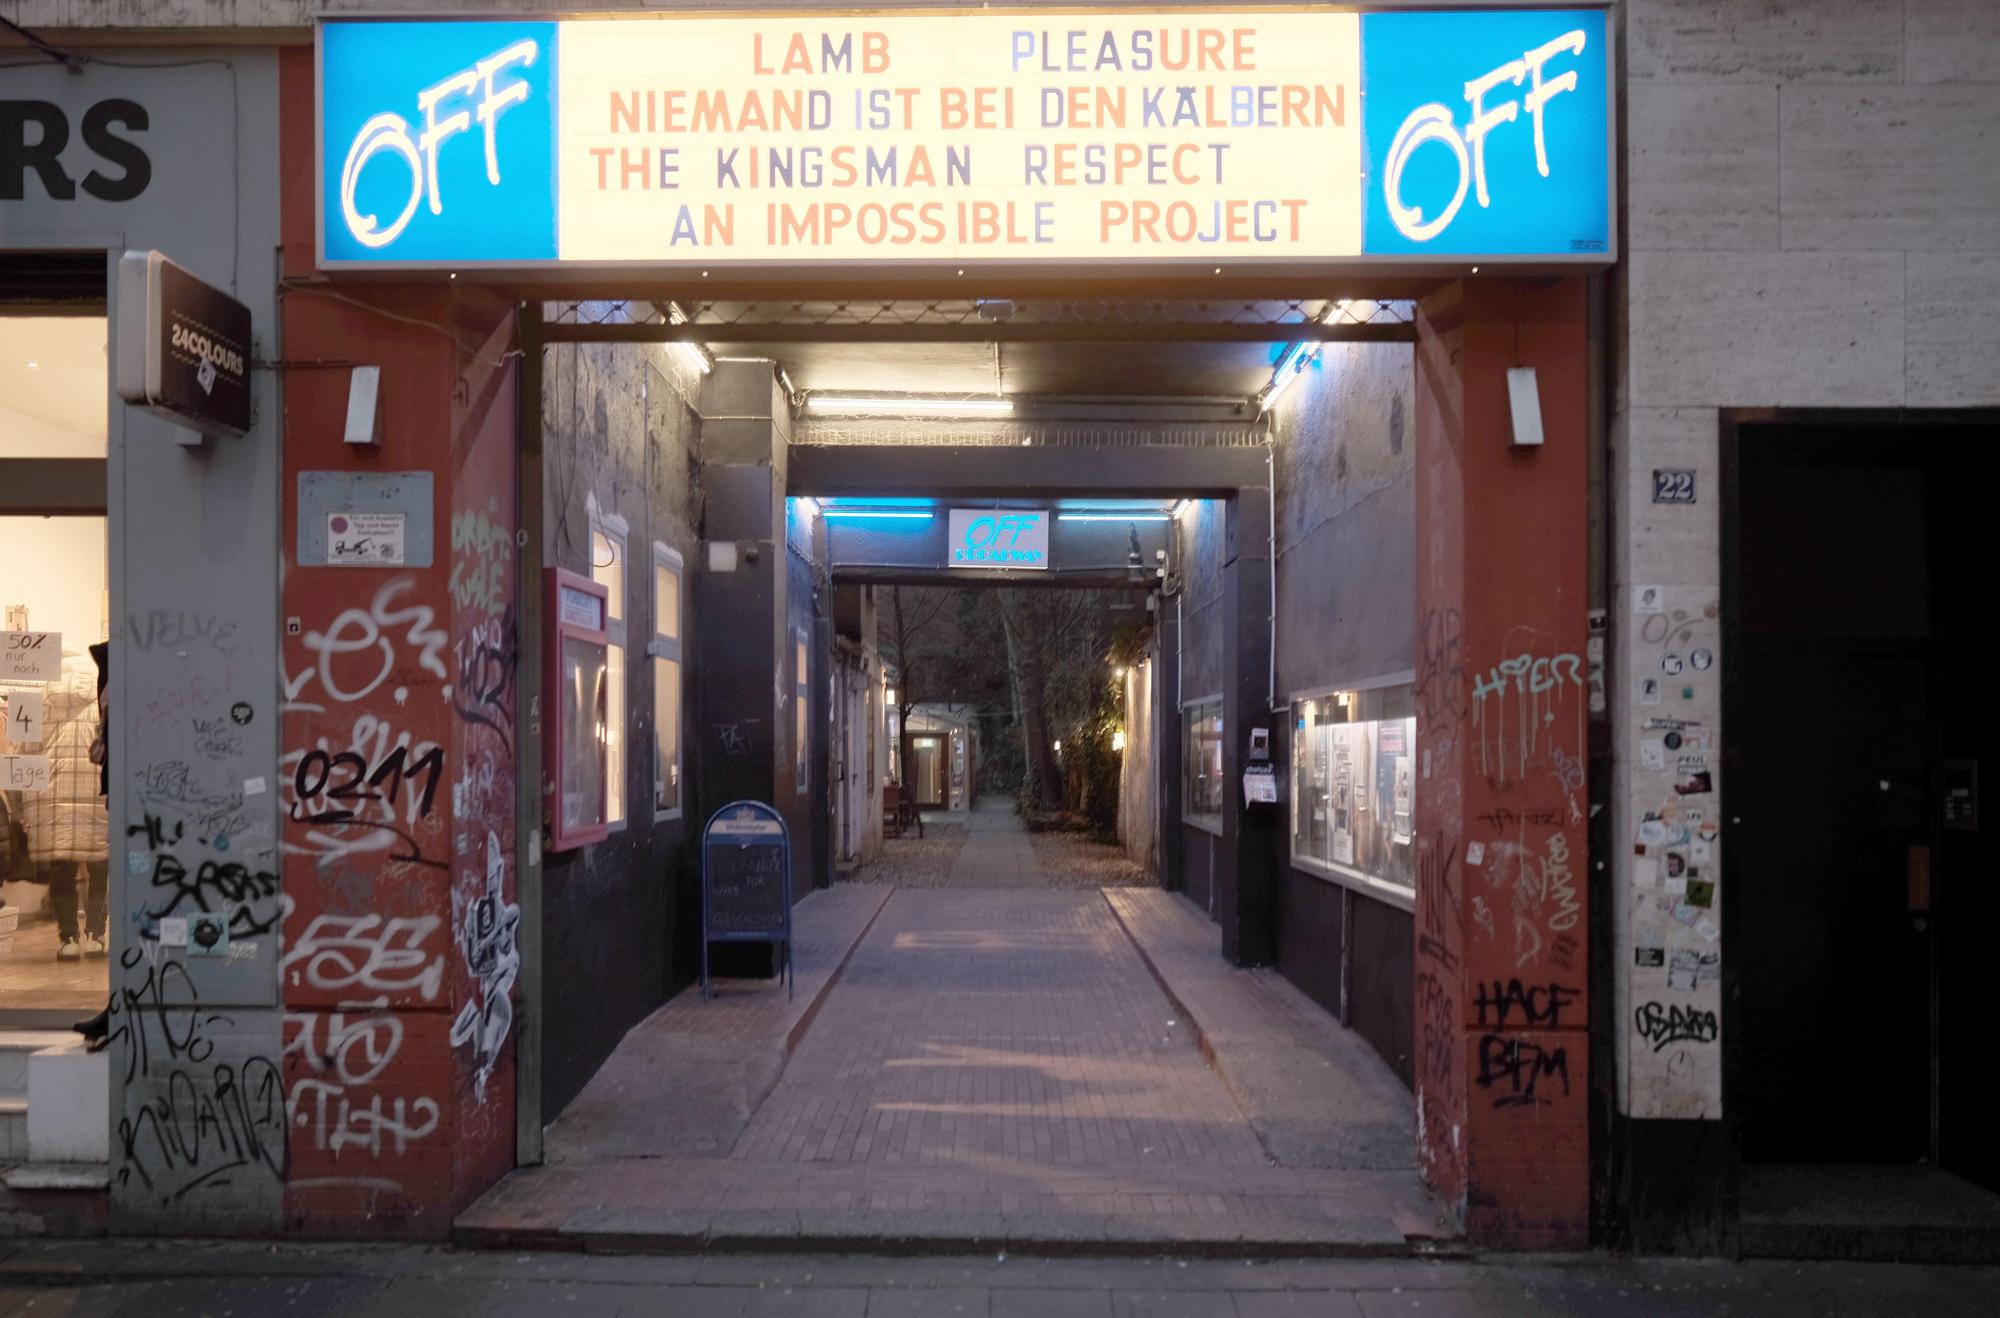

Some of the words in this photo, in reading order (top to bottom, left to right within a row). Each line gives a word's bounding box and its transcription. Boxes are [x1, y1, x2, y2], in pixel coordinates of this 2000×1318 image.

[753, 31, 891, 76] LAMB
[1011, 28, 1257, 72] PLEASURE
[609, 88, 832, 133] NIEMAND
[855, 88, 921, 131] IST
[939, 86, 1015, 130] BEI
[1040, 86, 1127, 129] DEN
[1143, 84, 1346, 128] KÄLBERN
[341, 39, 538, 247] OFF
[1384, 29, 1587, 241] OFF
[589, 146, 679, 191] THE
[716, 145, 972, 189] KINGSMAN
[1023, 142, 1232, 186] RESPECT
[669, 202, 734, 247] AN
[766, 201, 1055, 246] IMPOSSIBLE
[1099, 199, 1308, 243] PROJECT
[171, 323, 244, 377] 24COLOURS
[1657, 471, 1692, 500] 22
[965, 514, 1041, 549] OFF
[4, 651, 26, 662] nur
[8, 633, 48, 650] 50%
[13, 663, 40, 675] noch
[15, 704, 33, 733] 4
[3, 756, 46, 788] Tage
